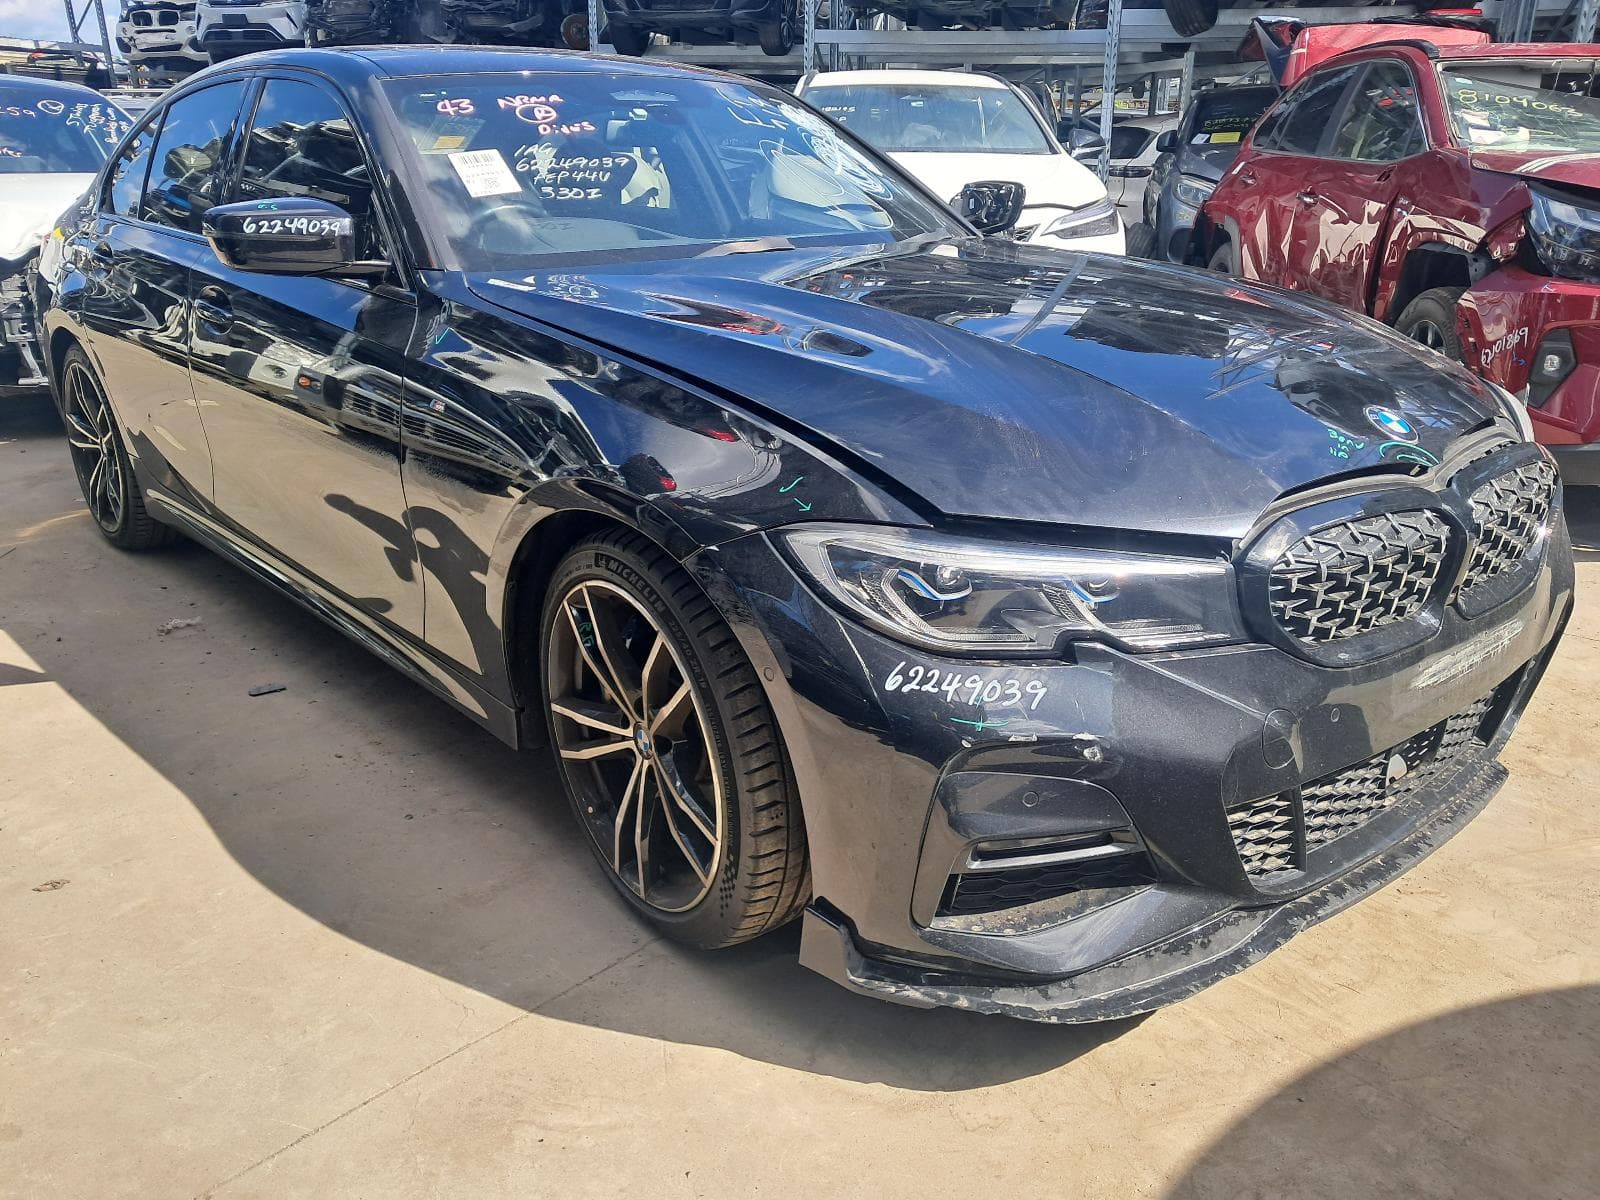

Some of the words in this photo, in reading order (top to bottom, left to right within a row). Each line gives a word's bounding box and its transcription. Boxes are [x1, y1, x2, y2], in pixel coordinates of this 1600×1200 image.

[436, 98, 474, 116] 43
[1458, 89, 1583, 117] 8104063
[516, 156, 630, 172] 62249039
[243, 217, 340, 236] 62249039
[608, 560, 669, 612] MICHELIN
[884, 661, 1048, 710] 62249039
